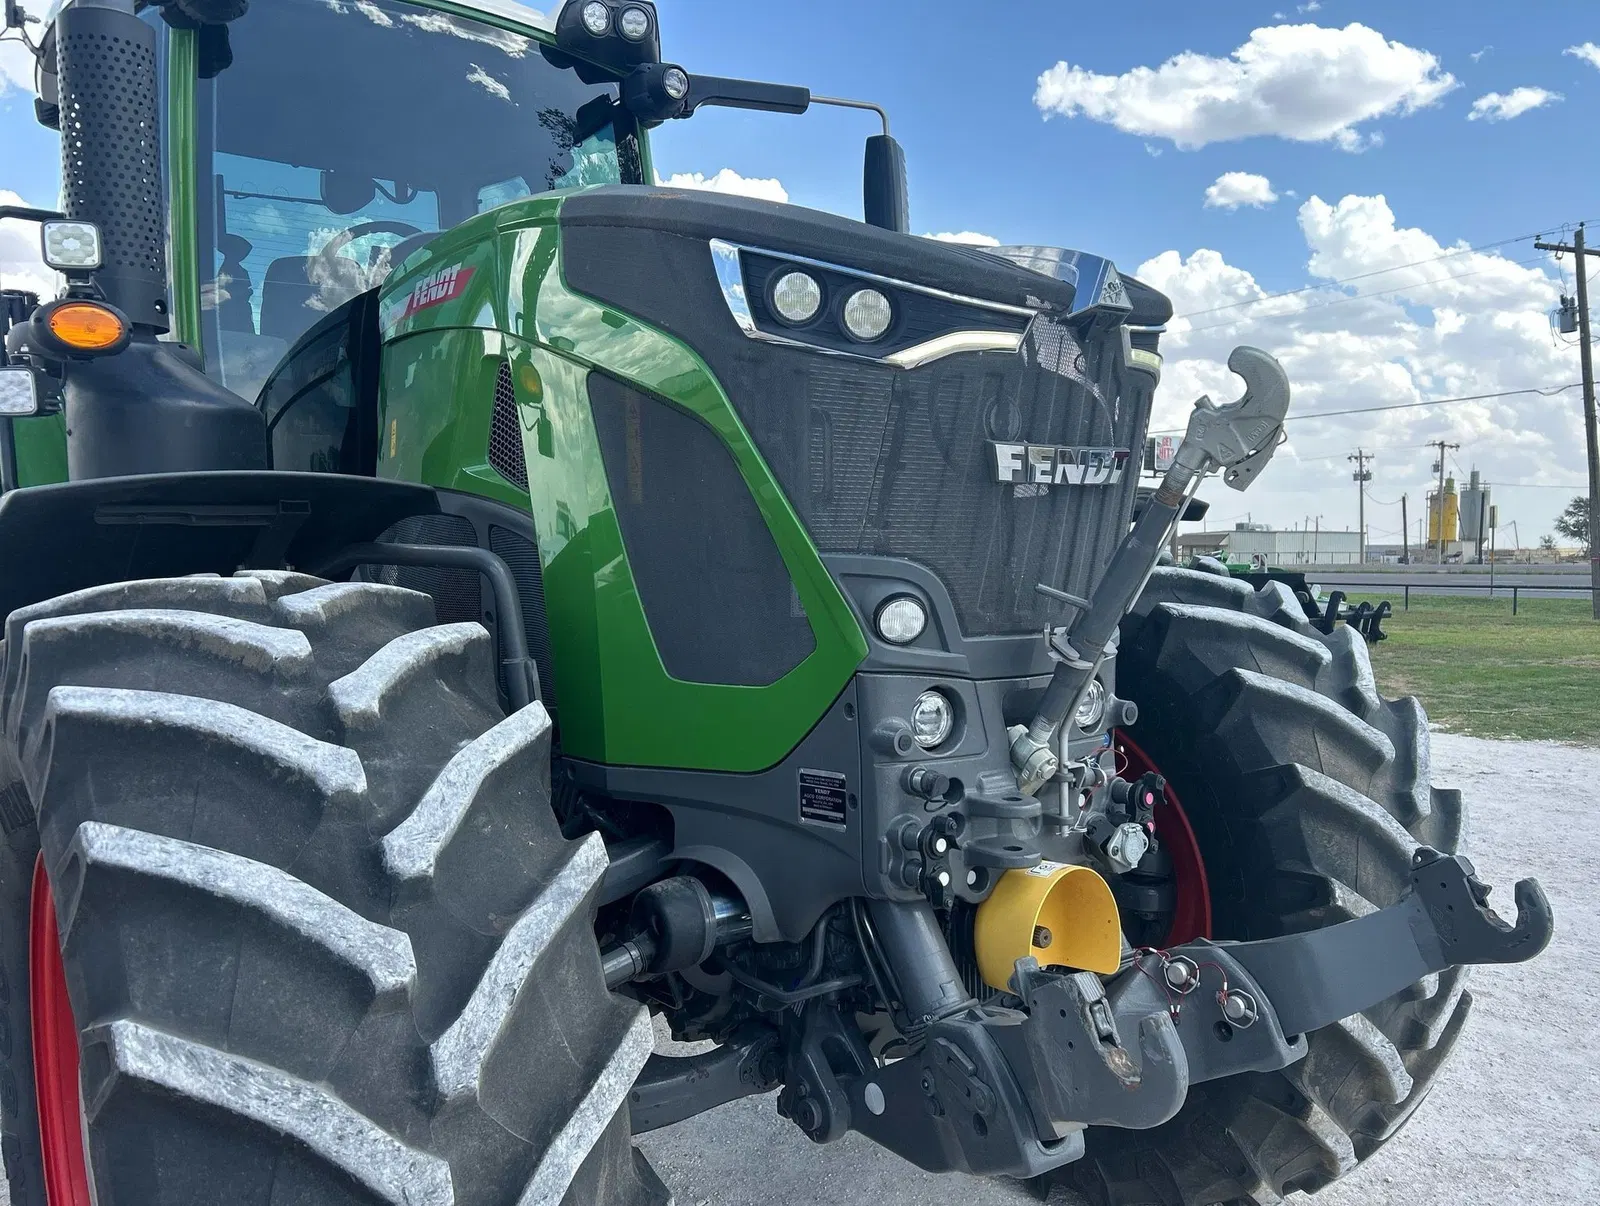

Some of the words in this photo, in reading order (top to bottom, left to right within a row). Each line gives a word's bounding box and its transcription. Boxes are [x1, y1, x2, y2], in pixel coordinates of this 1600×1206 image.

[412, 262, 462, 308] FENDT
[994, 443, 1130, 484] FENDT
[815, 794, 842, 803] CORPORATION
